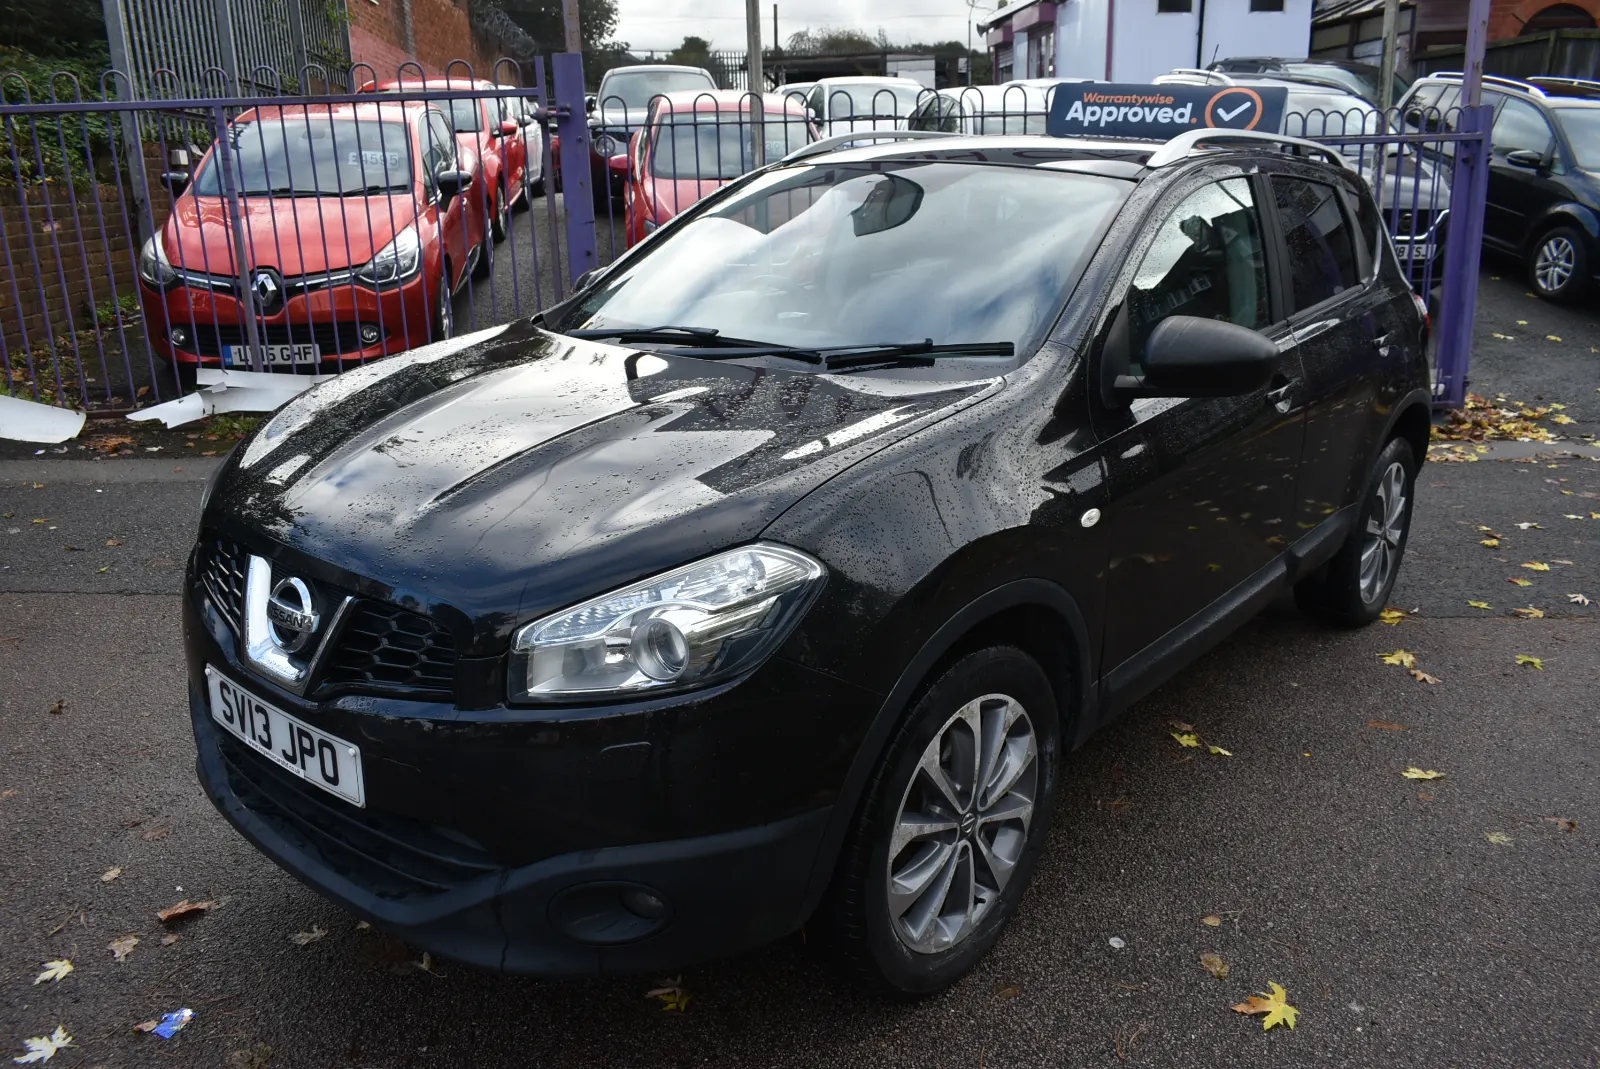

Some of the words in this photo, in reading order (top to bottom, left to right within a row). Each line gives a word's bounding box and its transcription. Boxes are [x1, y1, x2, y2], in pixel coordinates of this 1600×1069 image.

[1083, 92, 1174, 106] Warrantywise
[1065, 100, 1197, 126] Approved.
[237, 347, 276, 362] L15
[219, 680, 272, 750] SV13
